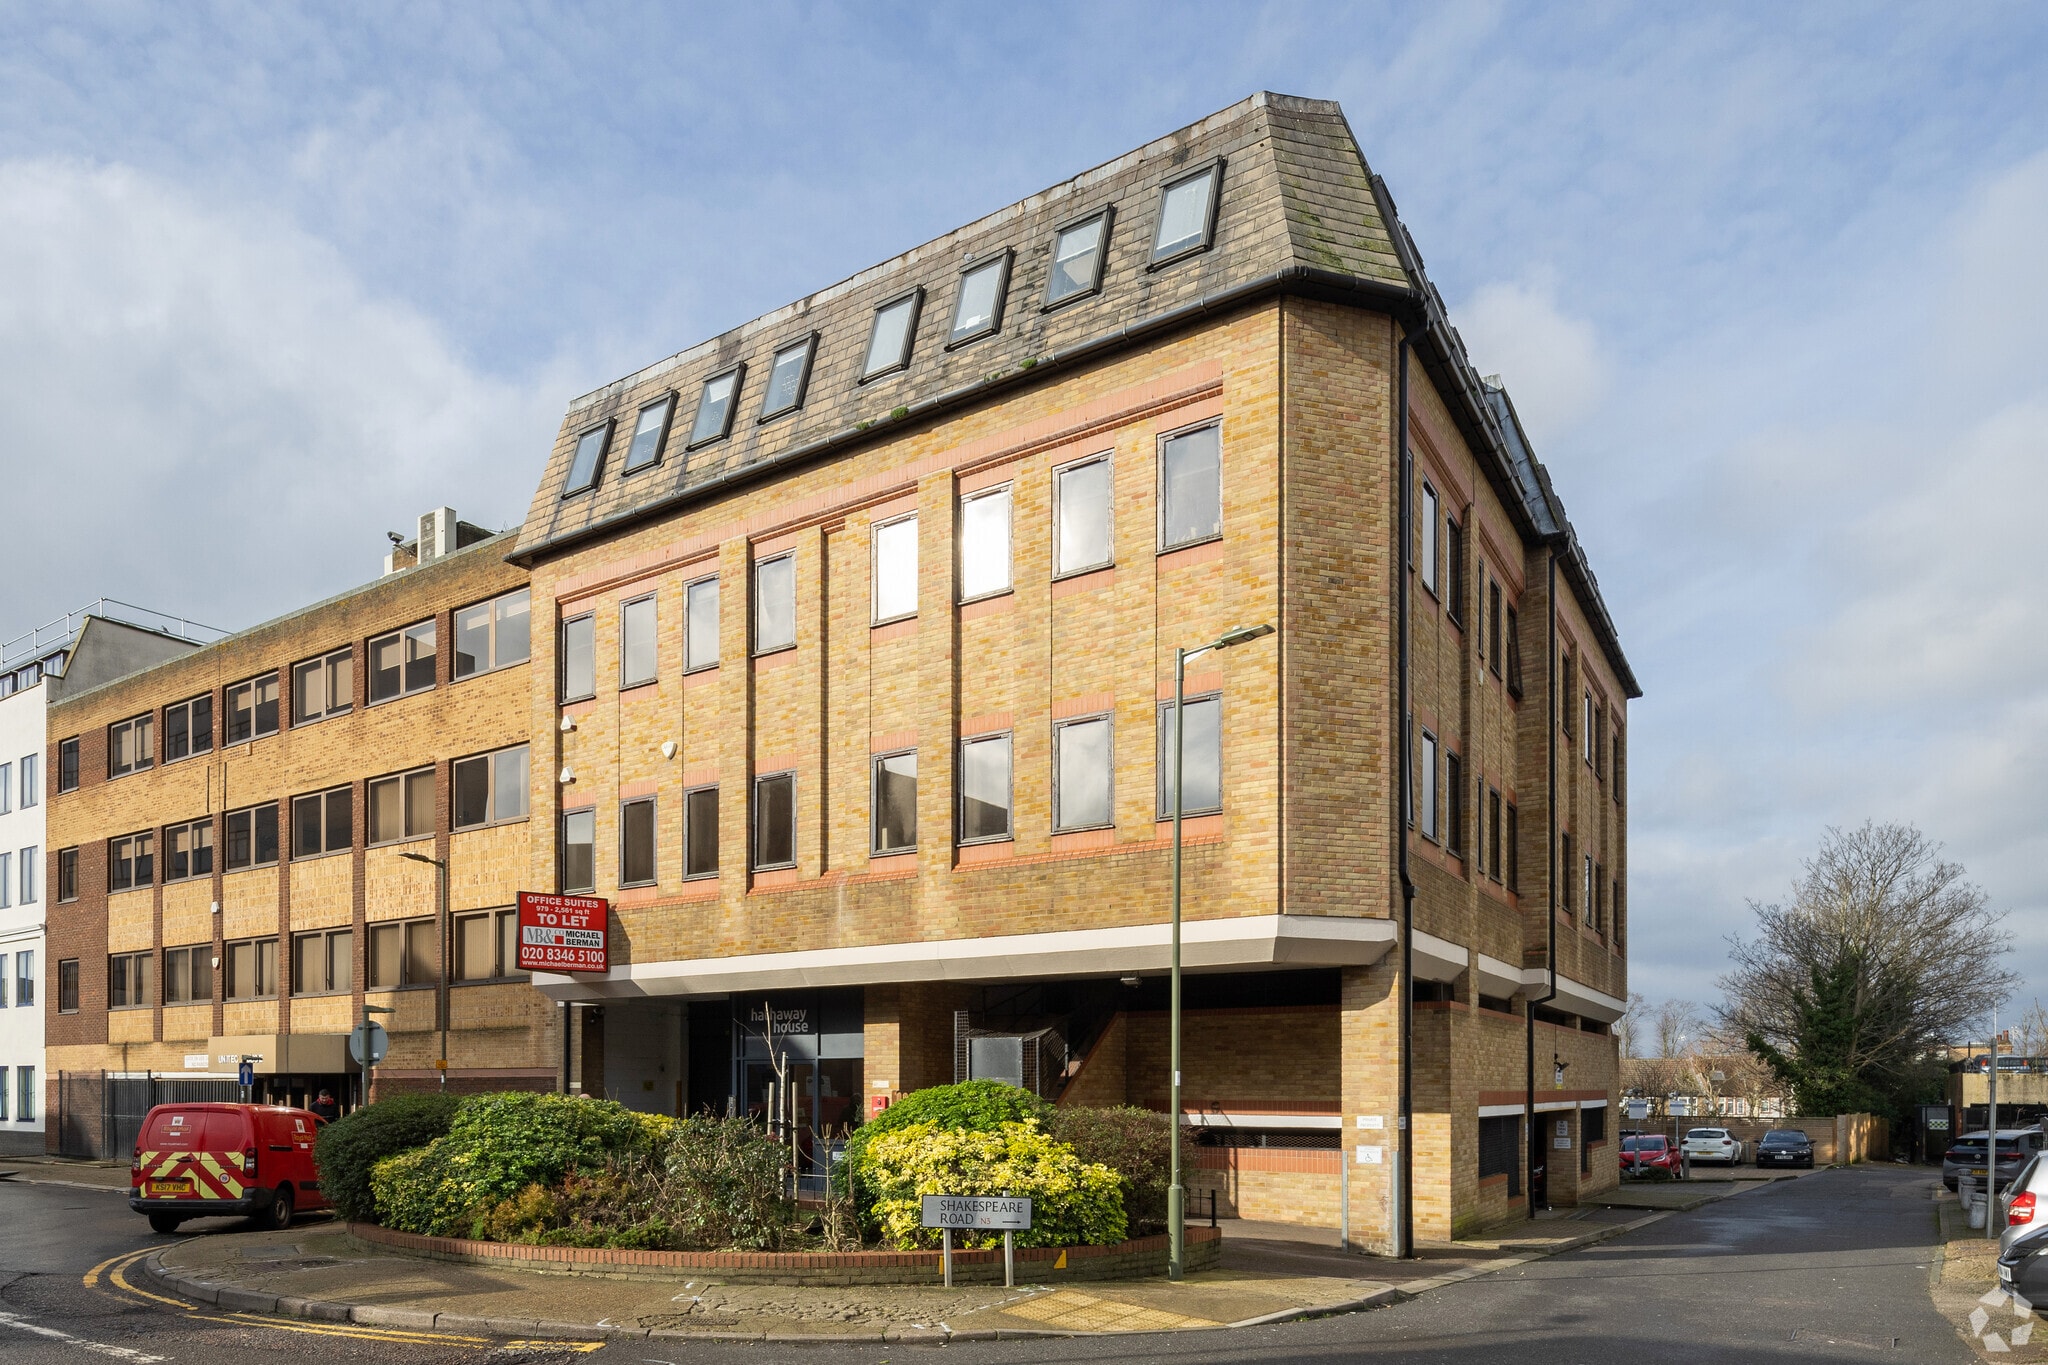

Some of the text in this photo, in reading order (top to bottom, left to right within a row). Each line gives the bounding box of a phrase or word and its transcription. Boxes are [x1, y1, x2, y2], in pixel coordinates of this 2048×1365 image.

[526, 895, 599, 908] OFFICE SUITES
[536, 913, 589, 927] TO LET
[566, 930, 600, 940] MICHAEL
[566, 938, 600, 947] BERMAN
[522, 946, 604, 963] 020 8346 5100
[522, 960, 604, 969] www.michaelberman.co.uk
[774, 1017, 808, 1033] house
[940, 1200, 1023, 1213] SHAKESPEARE
[940, 1213, 974, 1224] ROAD
